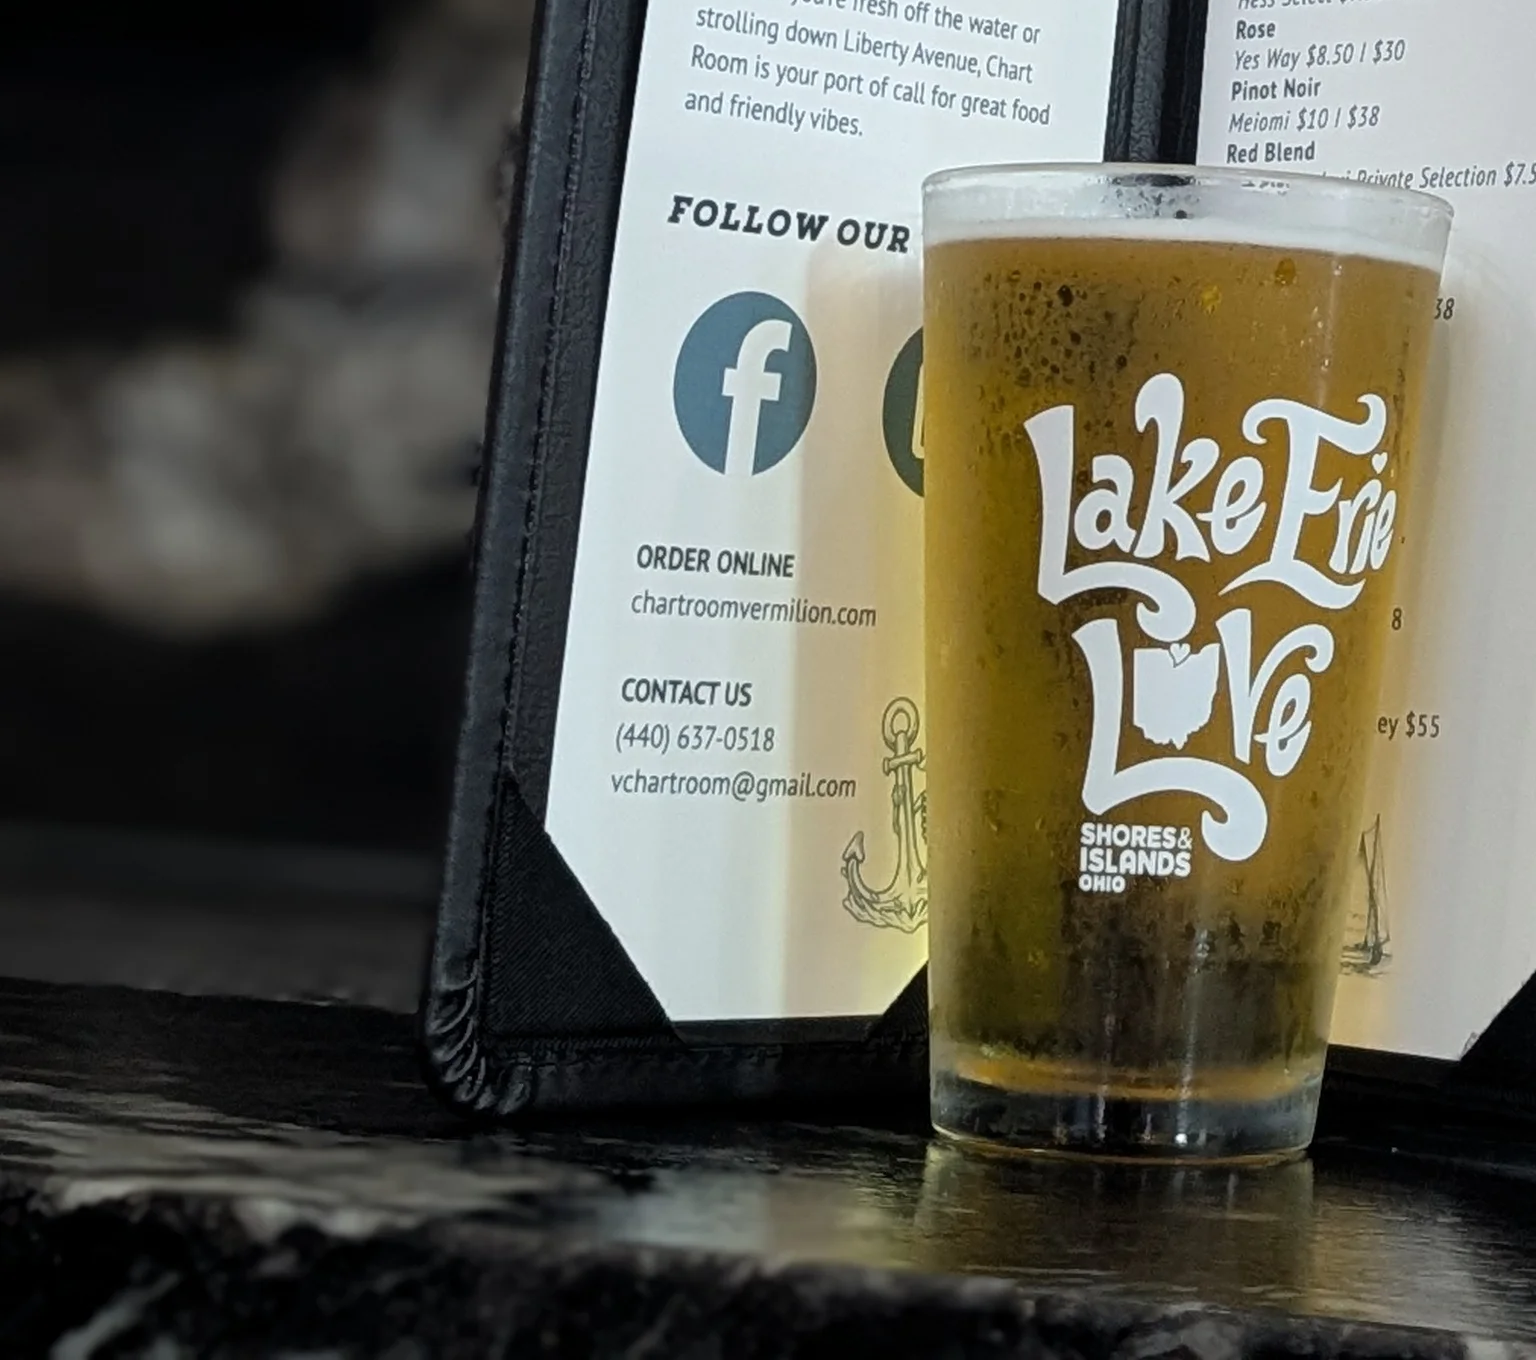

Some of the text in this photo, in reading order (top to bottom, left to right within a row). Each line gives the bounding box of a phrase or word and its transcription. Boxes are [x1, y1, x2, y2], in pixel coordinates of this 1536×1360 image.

[1235, 19, 1276, 41] Rose
[1235, 39, 1406, 72] Yes Way $8.50 $30
[1231, 76, 1322, 101] Pinot Noir
[1228, 104, 1380, 133] Meiomi $10 $38
[1226, 140, 1316, 164] Red Blend
[1419, 165, 1498, 189] Selection
[666, 194, 911, 254] FOLLOW OUR
[1024, 373, 1397, 642] Lake Erie
[636, 544, 796, 578] ORDER ONLINE
[631, 589, 877, 627] chartroomvermilion.com
[621, 677, 753, 708] CONTACT US
[615, 722, 775, 755] (440) 637-0518
[1405, 711, 1441, 738] $55
[611, 768, 857, 803] vchartroom@gmail.com
[1080, 847, 1191, 877] ISLANDS
[1079, 874, 1126, 893] OHIO
